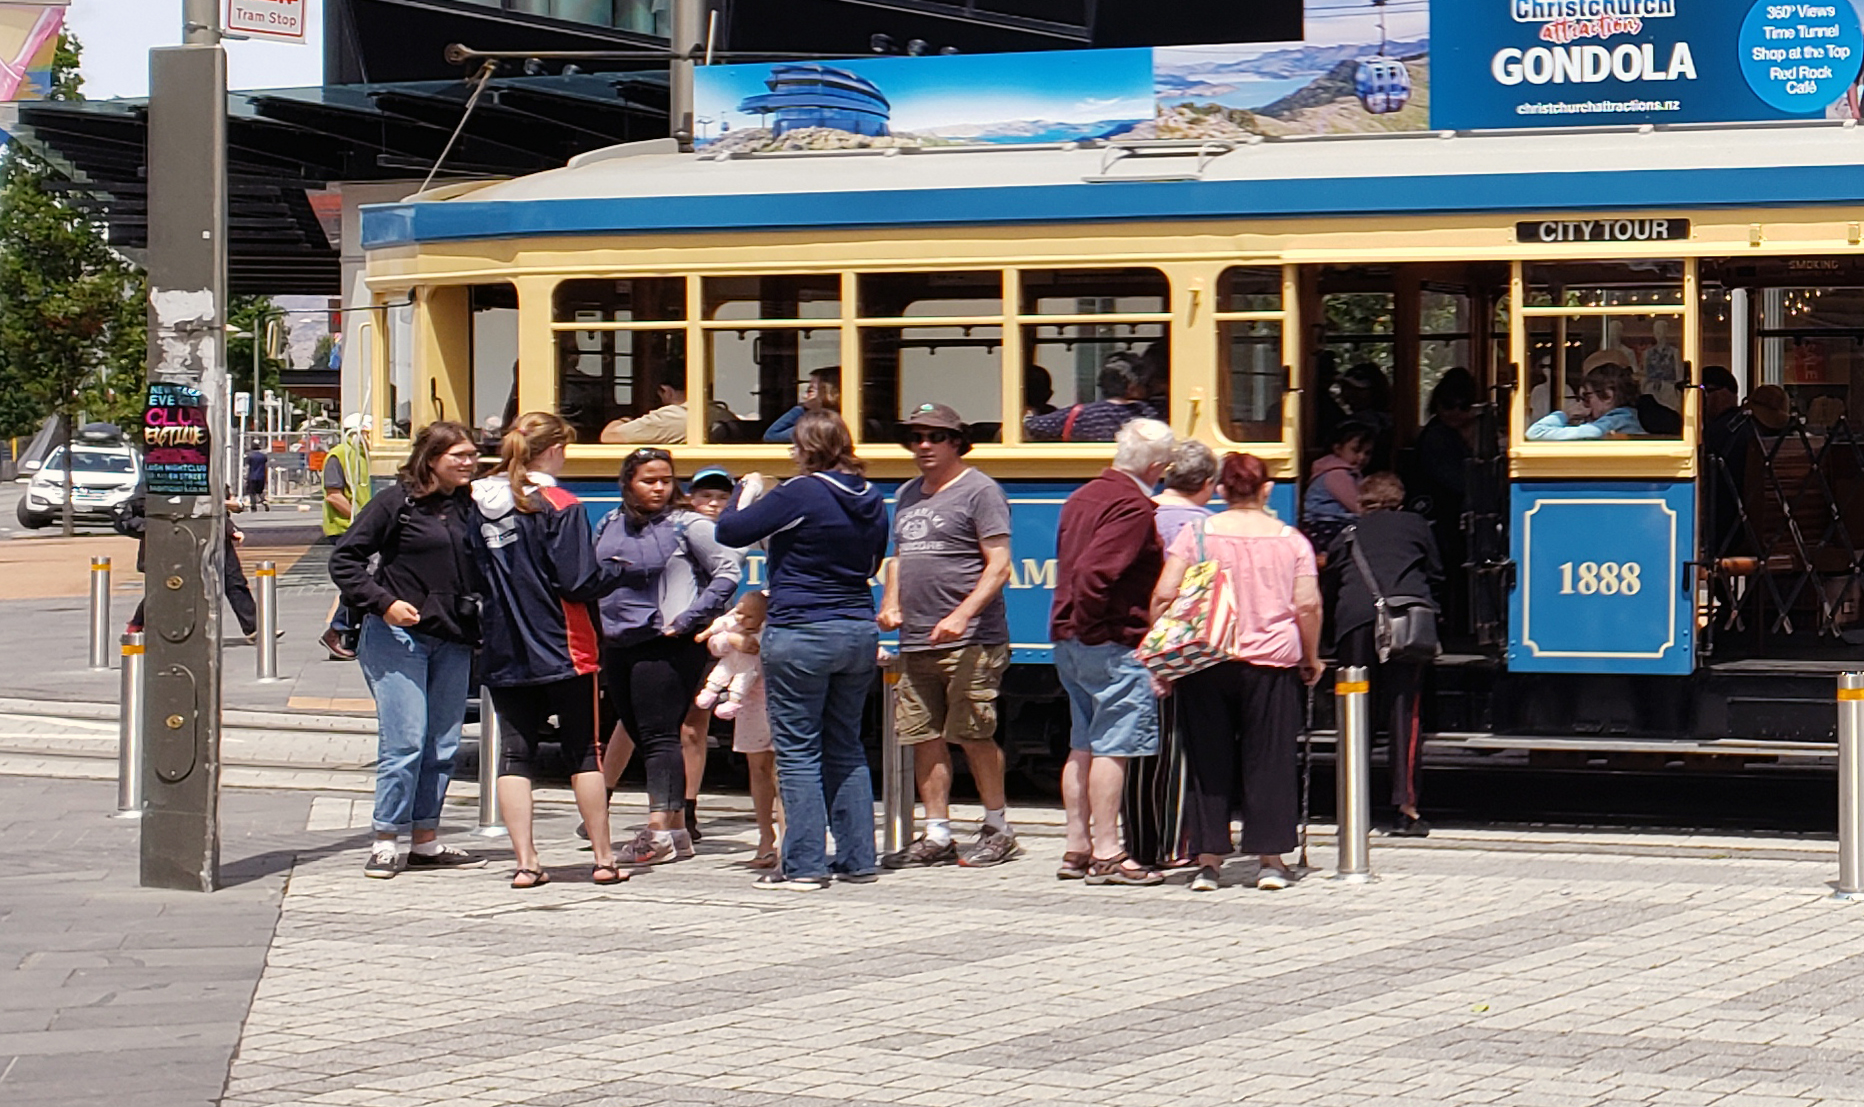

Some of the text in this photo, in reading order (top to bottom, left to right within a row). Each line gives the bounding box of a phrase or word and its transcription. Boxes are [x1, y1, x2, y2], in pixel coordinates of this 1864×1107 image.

[236, 7, 297, 28] Tram Stop
[1797, 4, 1836, 18] Views
[1763, 24, 1840, 40] Time Tunnel
[1752, 44, 1850, 62] Shop at the Top
[1491, 42, 1697, 85] GONDOLA
[1770, 65, 1833, 80] Red Rock
[1516, 99, 1681, 115] christchurchattractions.nz
[1539, 219, 1669, 242] CITY TOUR
[148, 395, 176, 406] EVE
[1558, 561, 1641, 596] 1888
